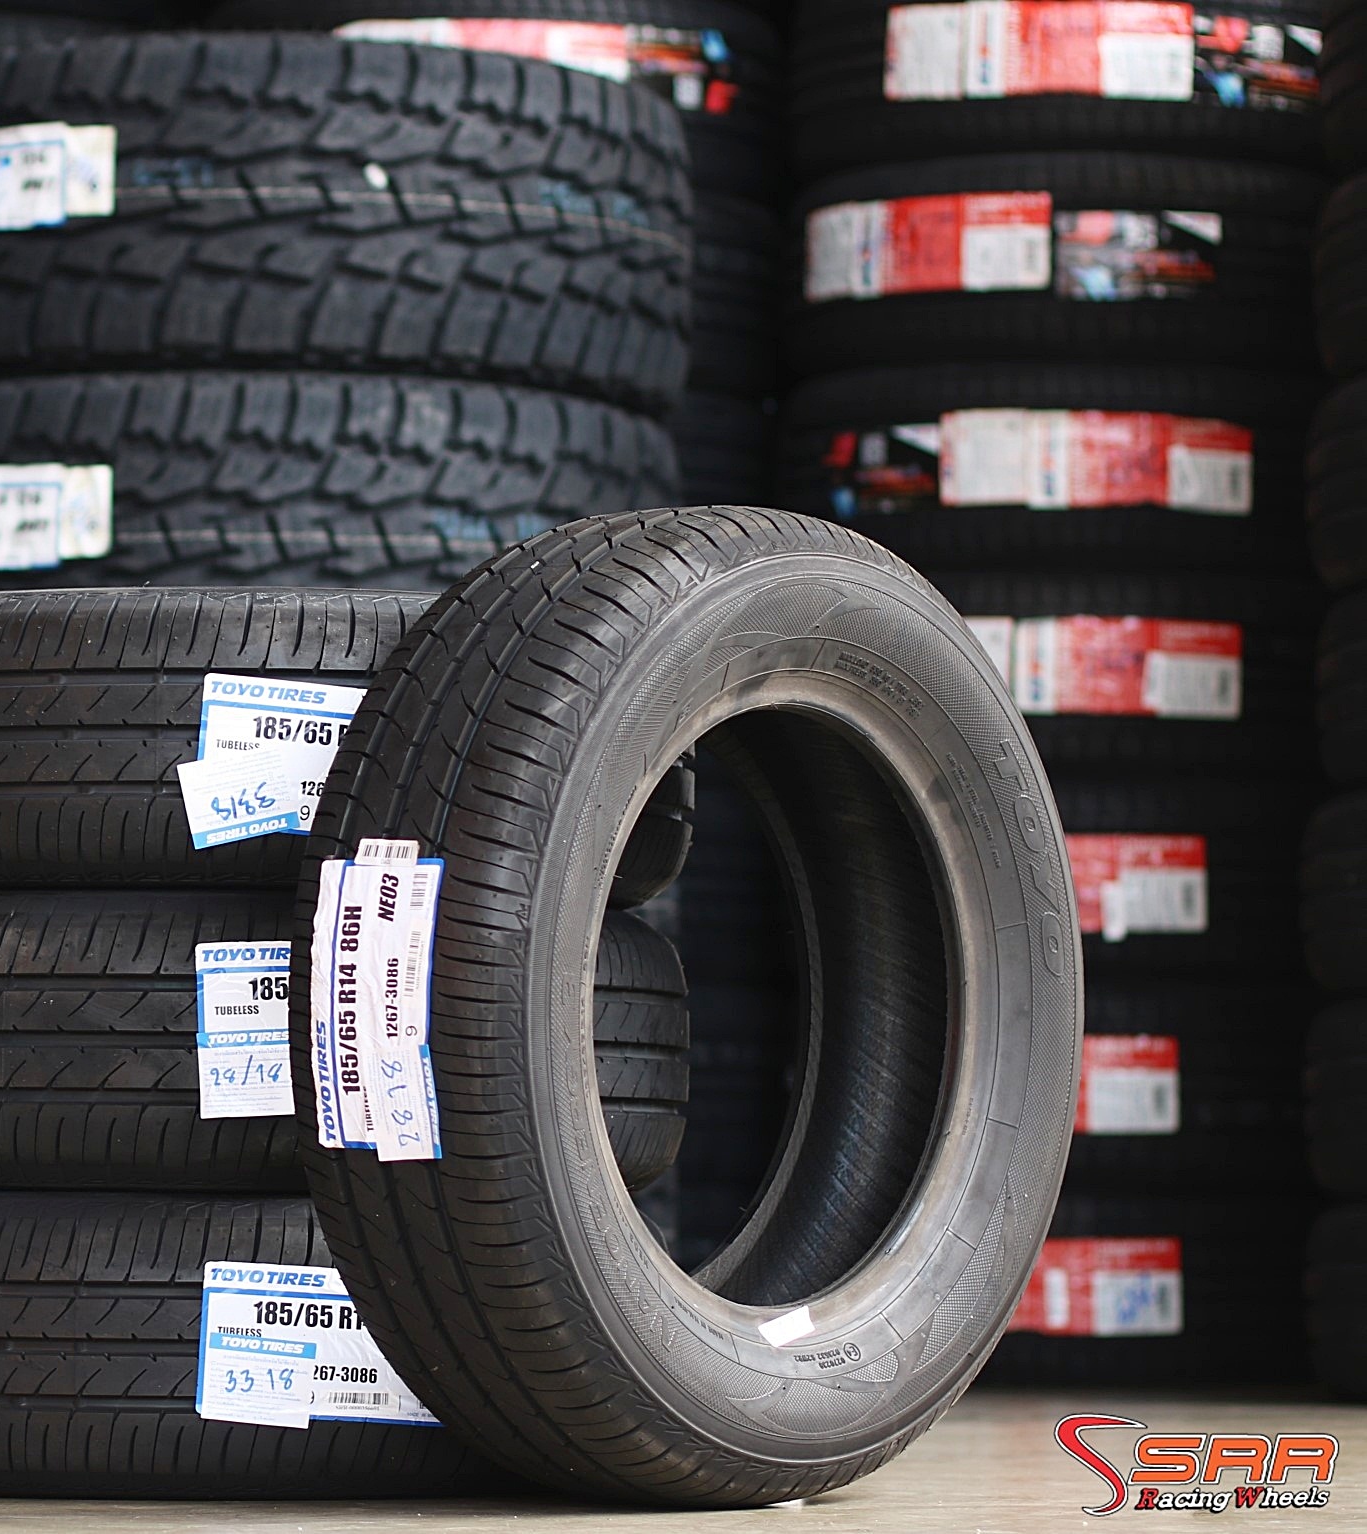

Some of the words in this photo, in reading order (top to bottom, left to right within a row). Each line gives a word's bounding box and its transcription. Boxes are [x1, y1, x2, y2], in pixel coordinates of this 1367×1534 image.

[211, 680, 265, 697] TOYO
[268, 688, 327, 705] TIRES
[252, 715, 332, 746] 185/65
[216, 739, 261, 751] TUBELESS
[249, 817, 288, 834] TOYO
[300, 805, 311, 821] 9
[206, 828, 247, 844] TIRES
[993, 738, 1066, 977] TOYO
[340, 904, 363, 953] 86H
[202, 948, 256, 962] TOYO
[248, 976, 289, 1001] 185
[338, 963, 358, 1005] R14
[214, 1004, 260, 1016] TUBELESS
[386, 957, 399, 1039] 1267-3086
[208, 1032, 250, 1045] TOYO
[250, 1030, 289, 1043] TIRES
[315, 1020, 331, 1083] TIRES
[338, 1009, 361, 1097] 185/65
[320, 1086, 337, 1142] TOYO
[210, 1268, 264, 1284] TOYO
[267, 1271, 327, 1287] TIRES
[253, 1301, 333, 1328] 185/65
[221, 1336, 262, 1350] TOYO
[262, 1340, 305, 1354] TIRES
